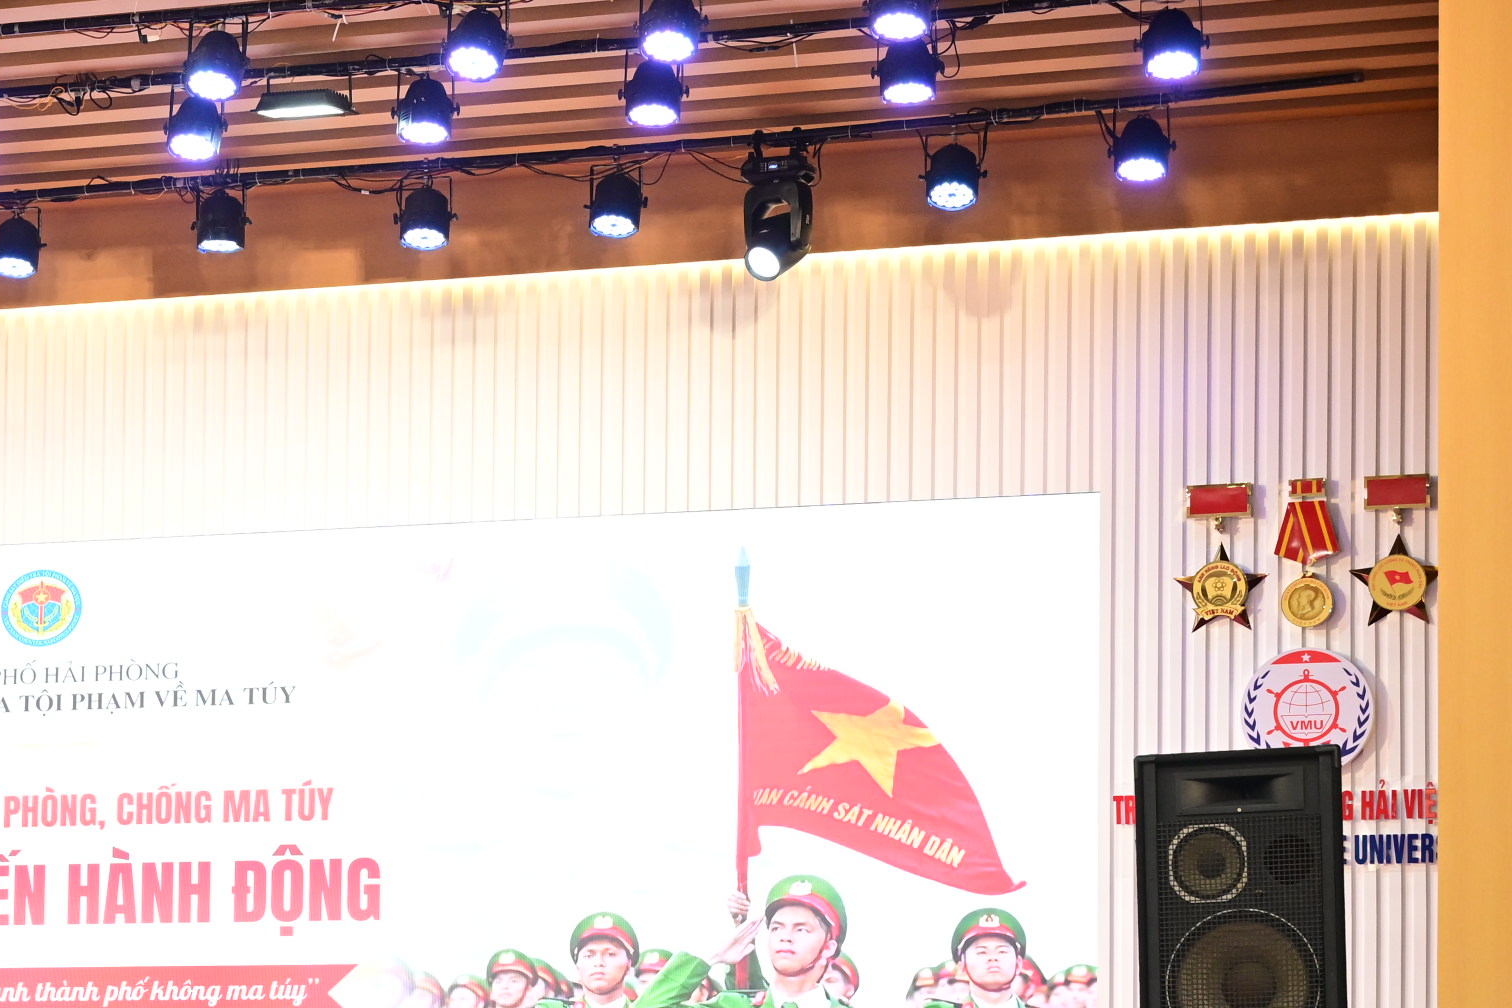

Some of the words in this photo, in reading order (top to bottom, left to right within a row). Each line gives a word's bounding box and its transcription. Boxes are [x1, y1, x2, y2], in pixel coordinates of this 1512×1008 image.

[1219, 607, 1235, 616] NAM
[44, 660, 86, 684] HẢI
[94, 658, 180, 683] PHÒNG
[19, 689, 64, 717] TỘI
[71, 690, 146, 716] PHẠM
[154, 680, 189, 709] VỀ
[195, 687, 236, 708] MA
[243, 680, 297, 707] TÚY
[1289, 719, 1325, 731] VMU
[3, 786, 106, 831] PHÒNG,
[116, 783, 213, 826] CHỐNG
[222, 789, 271, 823] MA
[281, 779, 334, 822] TÚY
[1360, 779, 1399, 821] HẢI
[1403, 781, 1439, 825] VIỆ
[832, 803, 873, 828] SÁT
[870, 812, 927, 850] NHÂN
[922, 837, 967, 869] DÂN
[1354, 833, 1439, 865] UNIVER
[67, 846, 211, 925] HÀNH
[231, 844, 381, 937] ĐỘNG
[34, 980, 101, 1003] thành
[102, 975, 152, 1008] phố
[150, 977, 223, 1007] không
[225, 984, 266, 1002] ma
